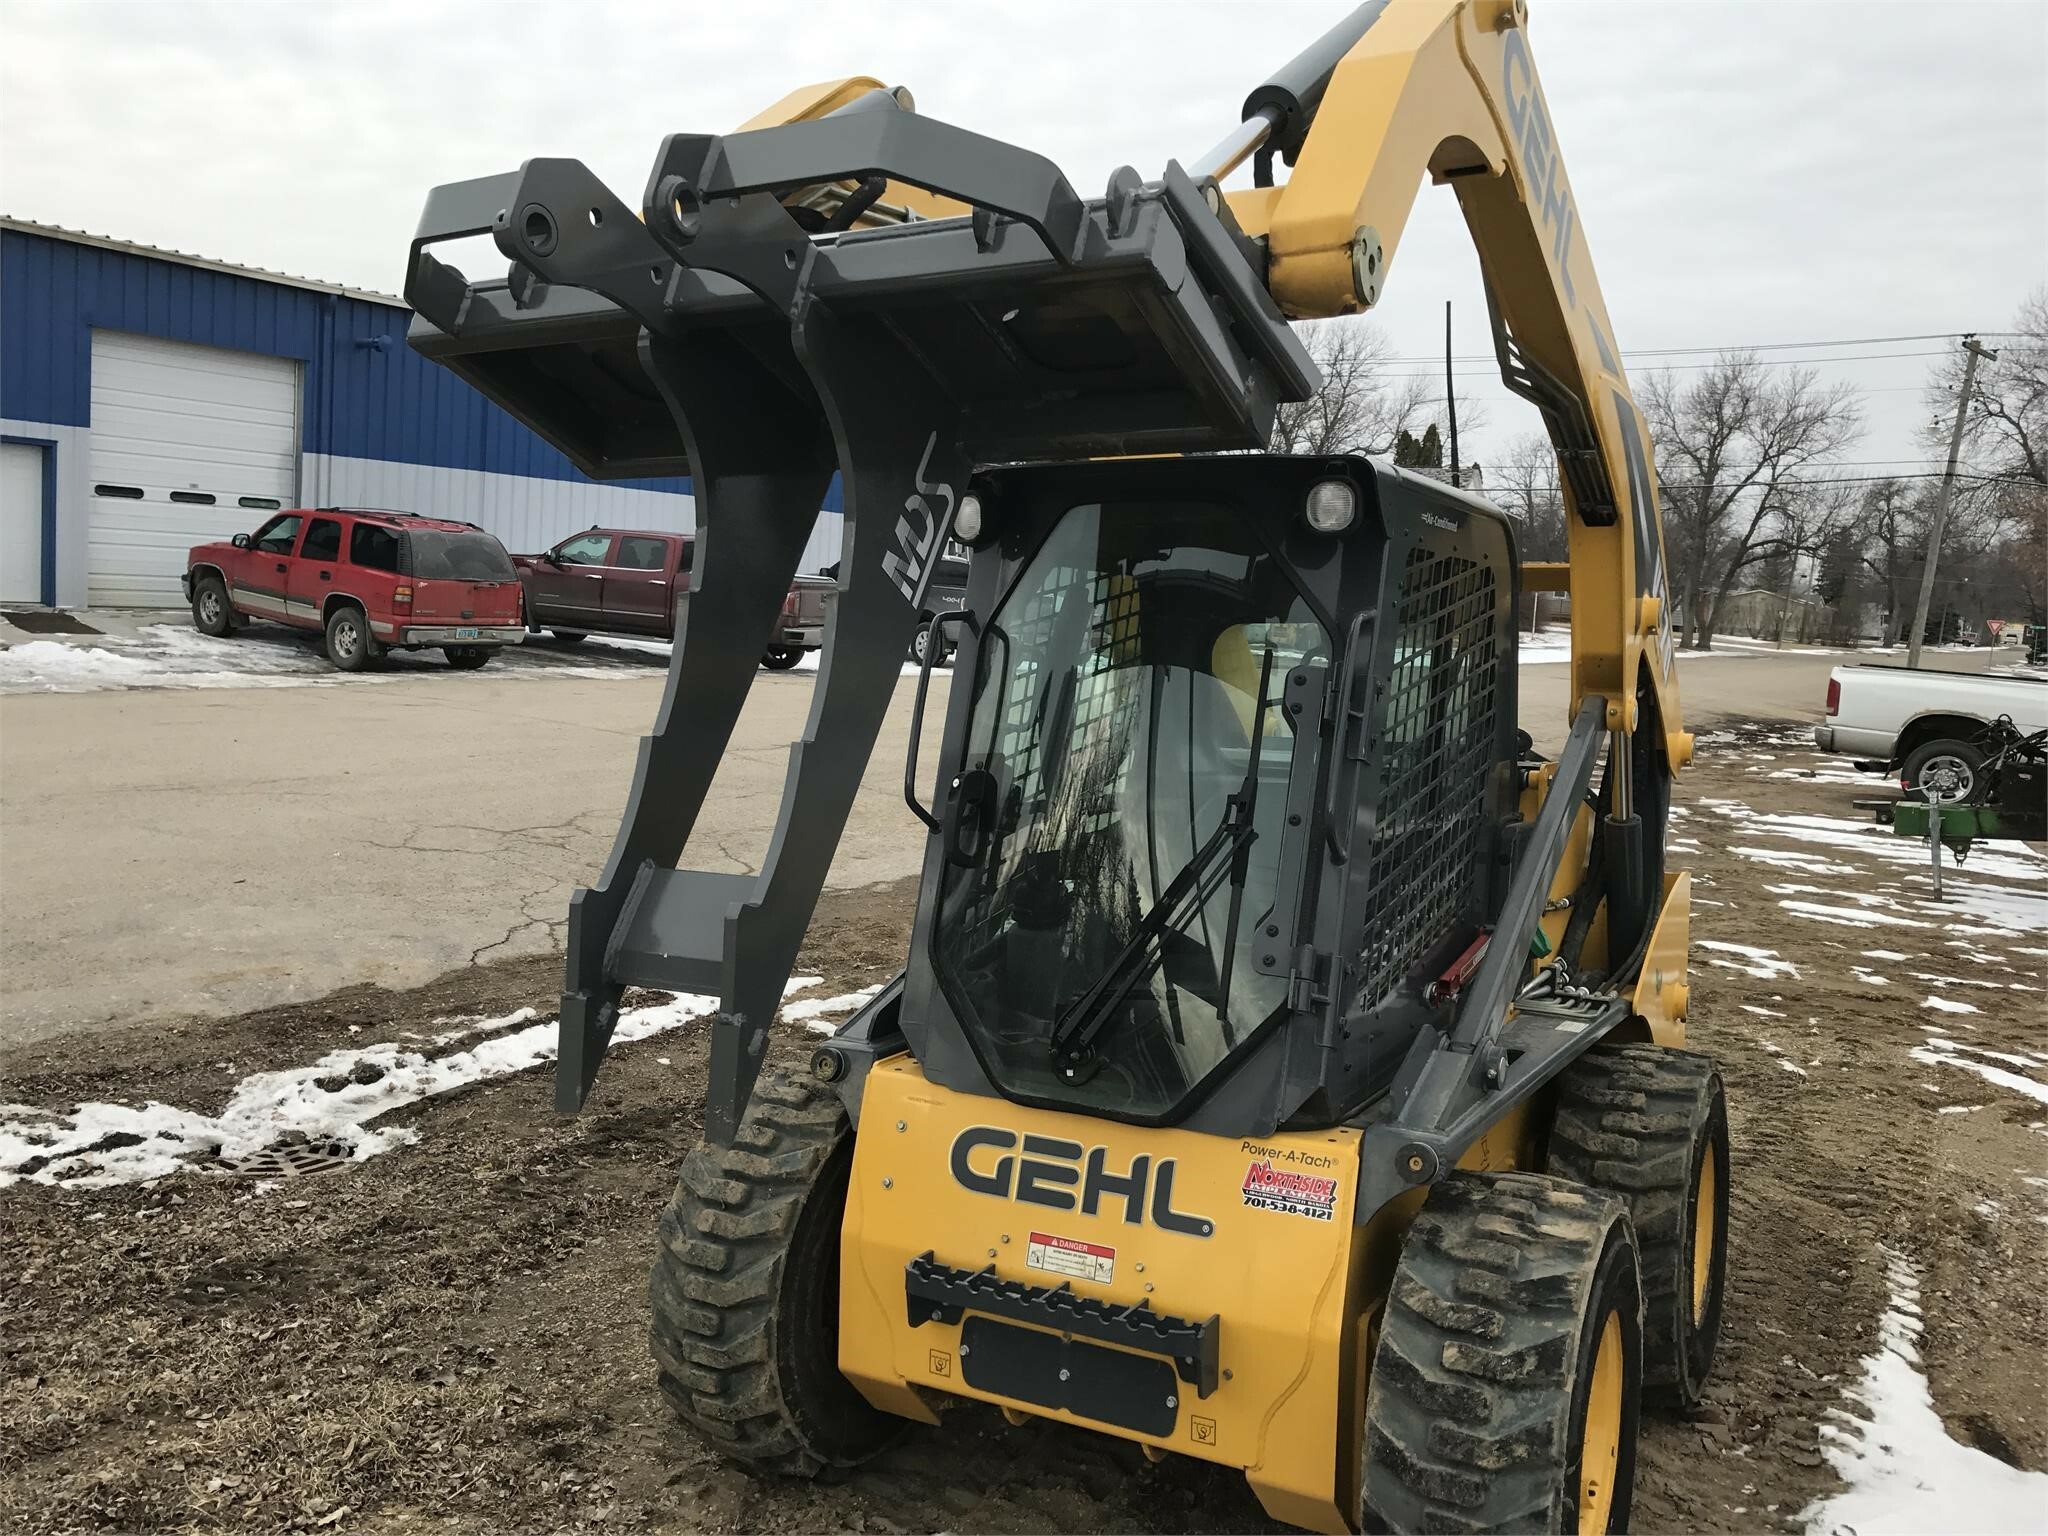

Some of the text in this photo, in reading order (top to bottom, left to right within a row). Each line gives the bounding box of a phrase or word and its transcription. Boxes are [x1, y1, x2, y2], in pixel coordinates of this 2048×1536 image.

[1503, 27, 1576, 311] GEHL
[950, 1125, 1215, 1238] GEHL
[1244, 1161, 1334, 1196] NORTHSIDE
[1244, 1196, 1332, 1220] 701-538-4121
[1059, 1240, 1089, 1252] DANGER
